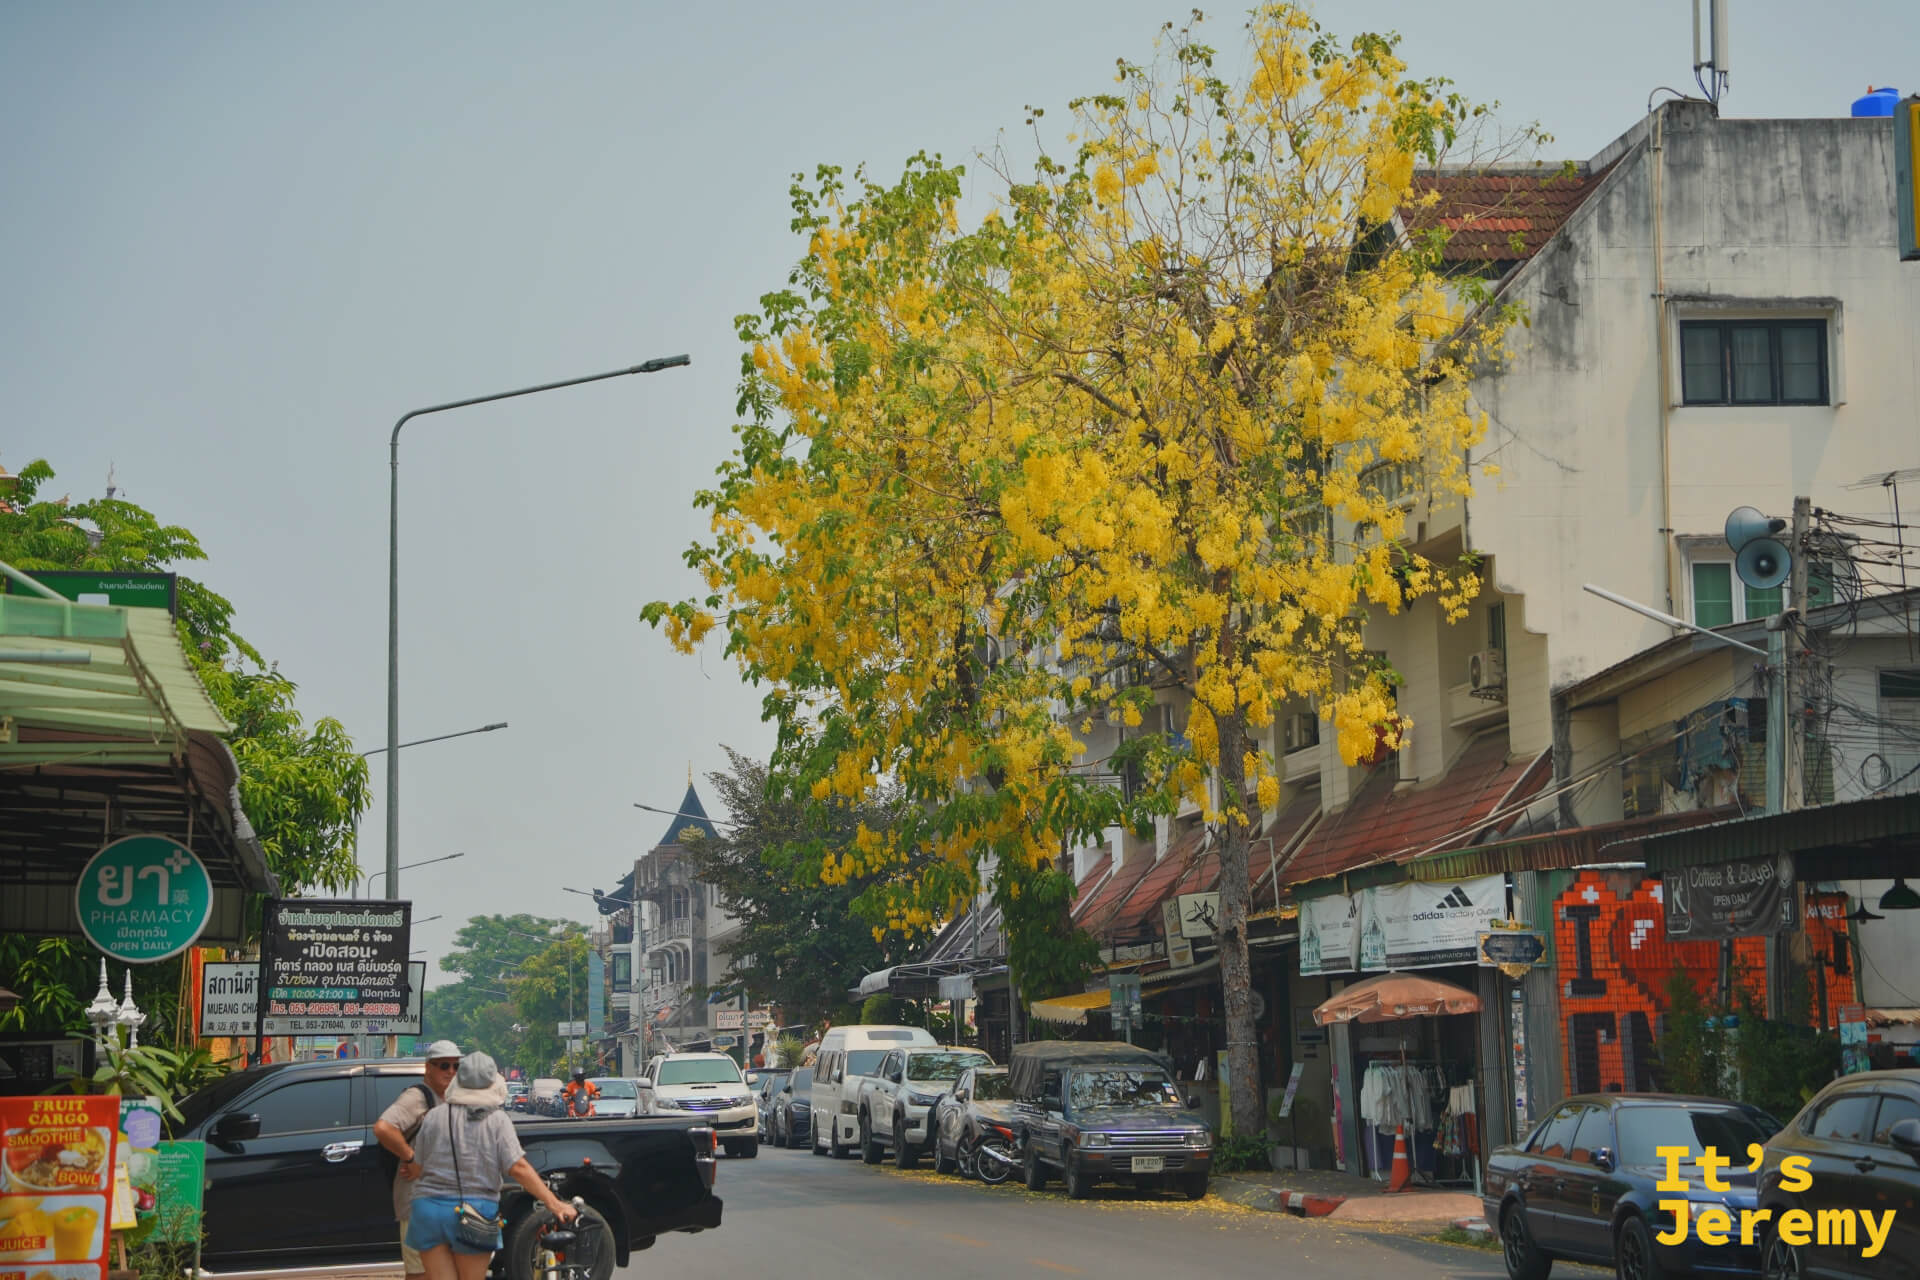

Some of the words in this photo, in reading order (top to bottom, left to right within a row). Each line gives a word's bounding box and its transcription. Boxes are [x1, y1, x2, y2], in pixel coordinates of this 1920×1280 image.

[97, 864, 169, 907] ยา
[91, 909, 194, 925] PHARMACY
[278, 908, 403, 930] จำหน่ายอุปกรณ์ดนตรี
[1412, 910, 1445, 921] adidas
[1445, 908, 1475, 920] Factory
[362, 932, 371, 942] 6
[110, 941, 139, 952] OPEN
[143, 941, 173, 951] DAILY
[304, 962, 333, 973] กลอง
[336, 962, 354, 973] เบส
[291, 990, 344, 999] 10:00-21:00
[207, 1002, 239, 1015] MUEANG
[32, 1100, 86, 1112] FRUIT
[28, 1113, 89, 1125] CARGO
[7, 1131, 82, 1147] SMOOTHIE
[58, 1172, 99, 1186] BOWL
[0, 1236, 41, 1250] JUICE
